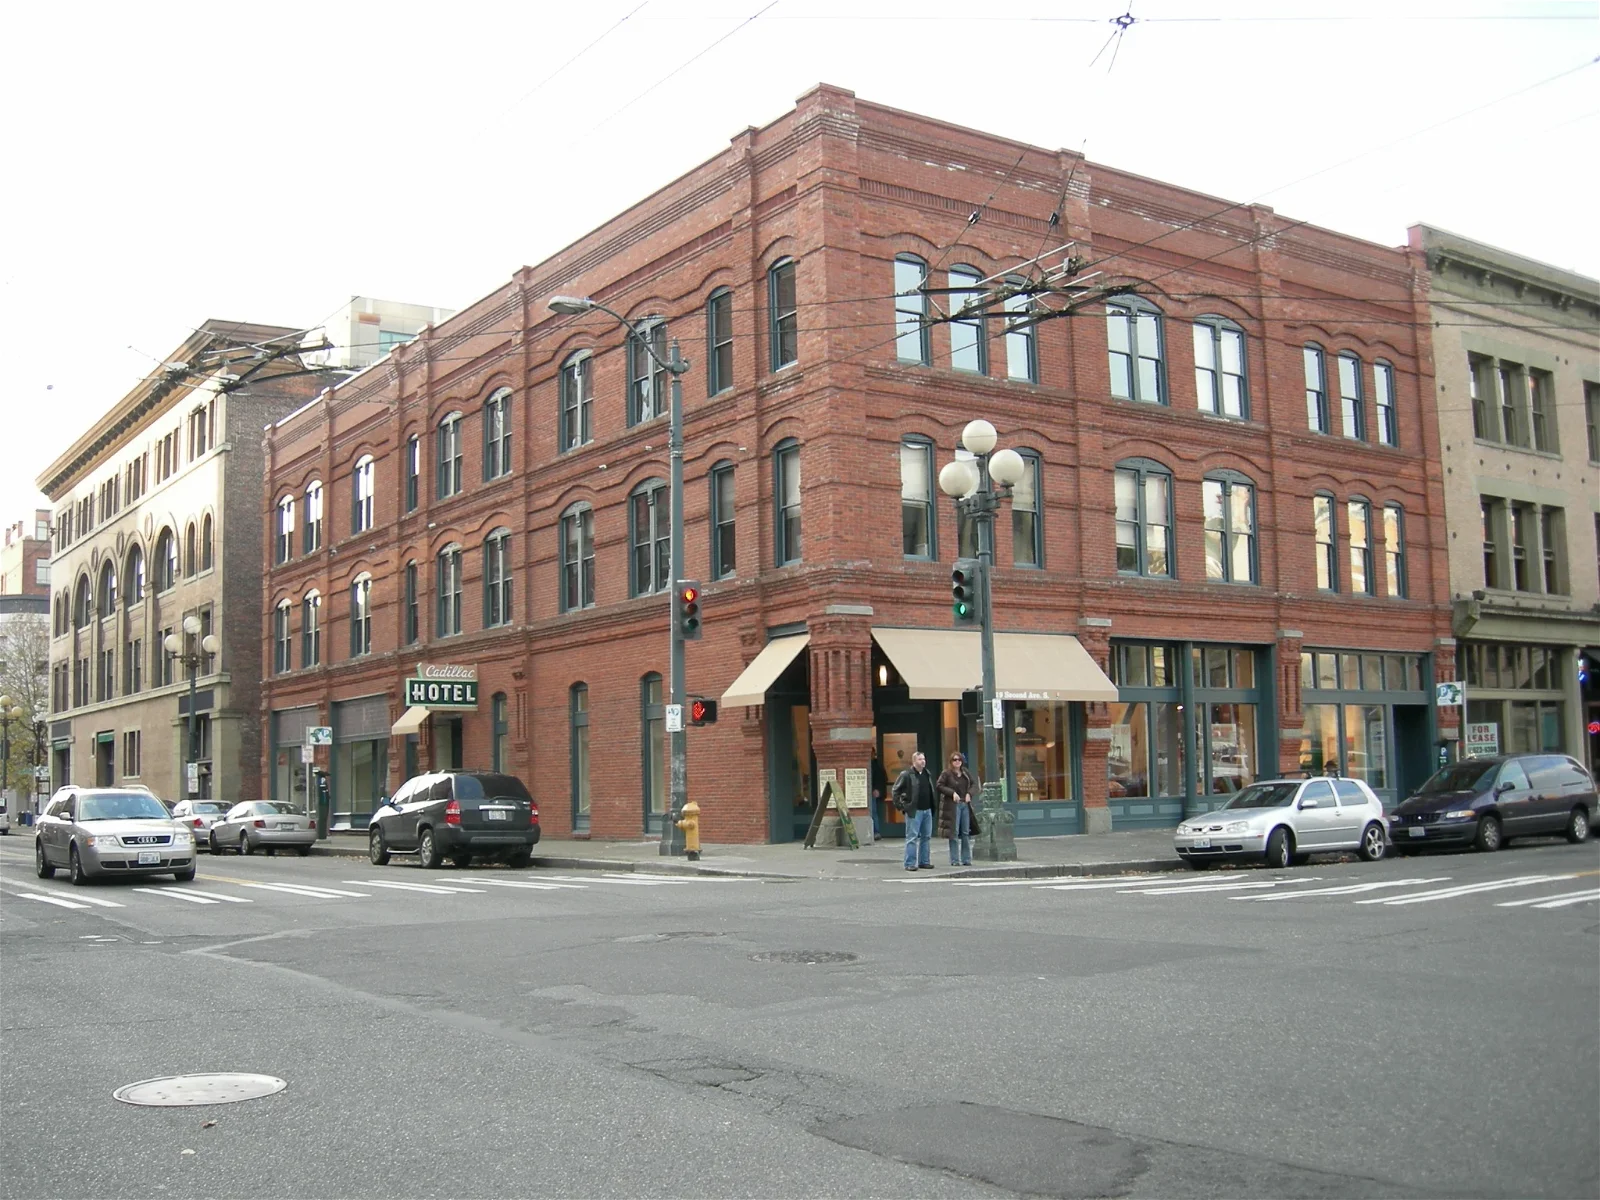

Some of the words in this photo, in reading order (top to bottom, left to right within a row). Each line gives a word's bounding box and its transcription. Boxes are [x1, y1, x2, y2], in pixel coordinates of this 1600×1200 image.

[425, 665, 475, 678] Cadillac
[412, 683, 476, 702] HOTEL
[1472, 725, 1490, 734] FOR
[1467, 733, 1496, 742] LEASE
